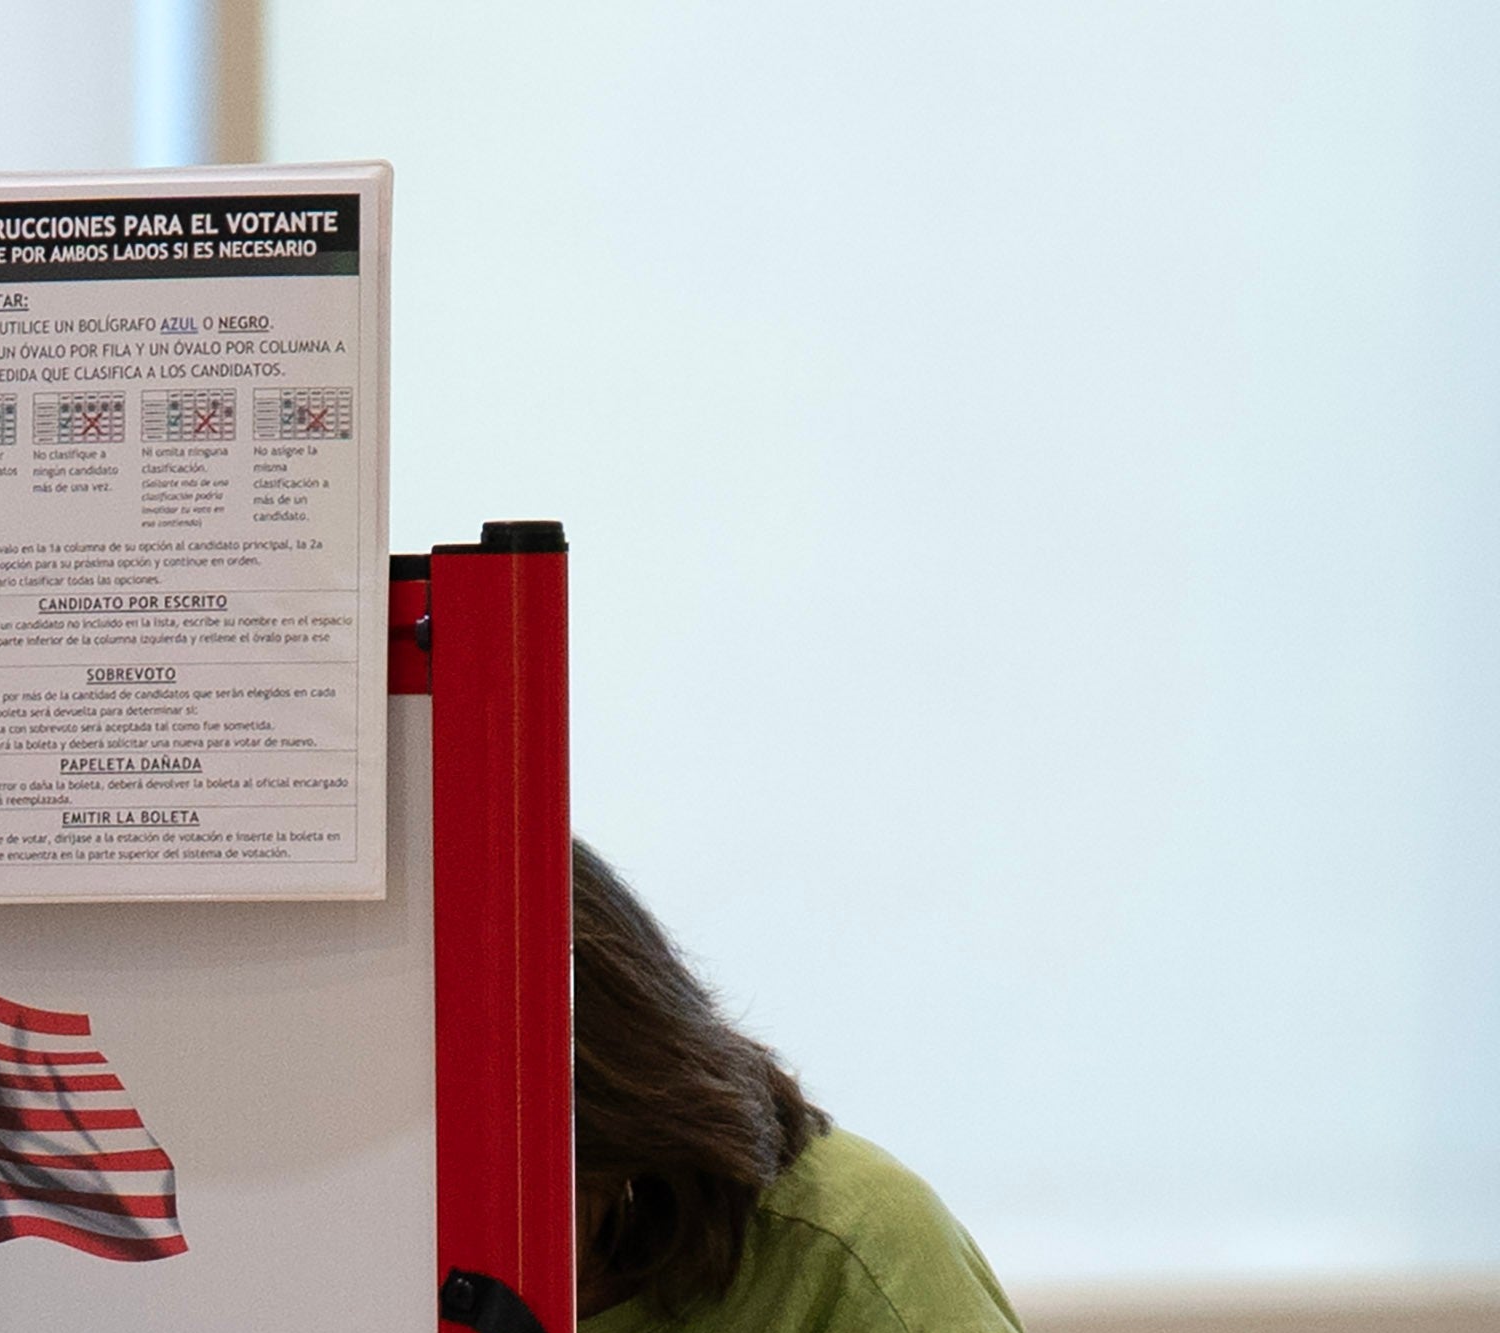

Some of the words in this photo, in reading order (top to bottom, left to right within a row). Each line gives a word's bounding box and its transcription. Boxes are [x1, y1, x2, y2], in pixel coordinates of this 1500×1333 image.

[124, 214, 183, 236] PARA
[191, 213, 219, 235] EL
[226, 211, 338, 234] VOTANTE
[12, 246, 46, 263] POR
[50, 244, 108, 263] AMBOS
[113, 243, 169, 261] LADOS
[173, 242, 188, 259] SI
[194, 241, 214, 258] ES
[219, 240, 317, 258] NECESARIO
[0, 320, 50, 335] UTILICE
[54, 320, 74, 334] UN
[78, 315, 156, 333] BOLÍGRAFO
[160, 317, 198, 331] AZUL
[203, 316, 214, 330] O
[218, 315, 274, 331] NEGRO.
[20, 342, 66, 359] ÓVALO
[70, 343, 98, 358] POR
[102, 343, 132, 357] FILA
[135, 343, 145, 356] Y
[149, 342, 169, 356] UN
[173, 339, 222, 356] ÓVALO
[225, 340, 255, 355] POR
[259, 340, 331, 354] COLUMNA
[335, 340, 346, 353] A
[41, 367, 69, 384] QUE
[74, 365, 143, 381] CLASIFICA
[146, 366, 156, 379] A
[160, 364, 187, 379] LOS
[190, 362, 285, 378] CANDIDATOS.
[39, 597, 123, 611] CANDIDATO
[129, 597, 158, 610] POR
[164, 595, 228, 609] ESCRITO
[87, 667, 176, 682] SOBREVOTO
[61, 757, 135, 772] PAPELETA
[141, 755, 202, 770] DAÑADA
[62, 811, 110, 825] EMITIR
[117, 811, 135, 825] LA
[141, 810, 199, 825] BOLETA
